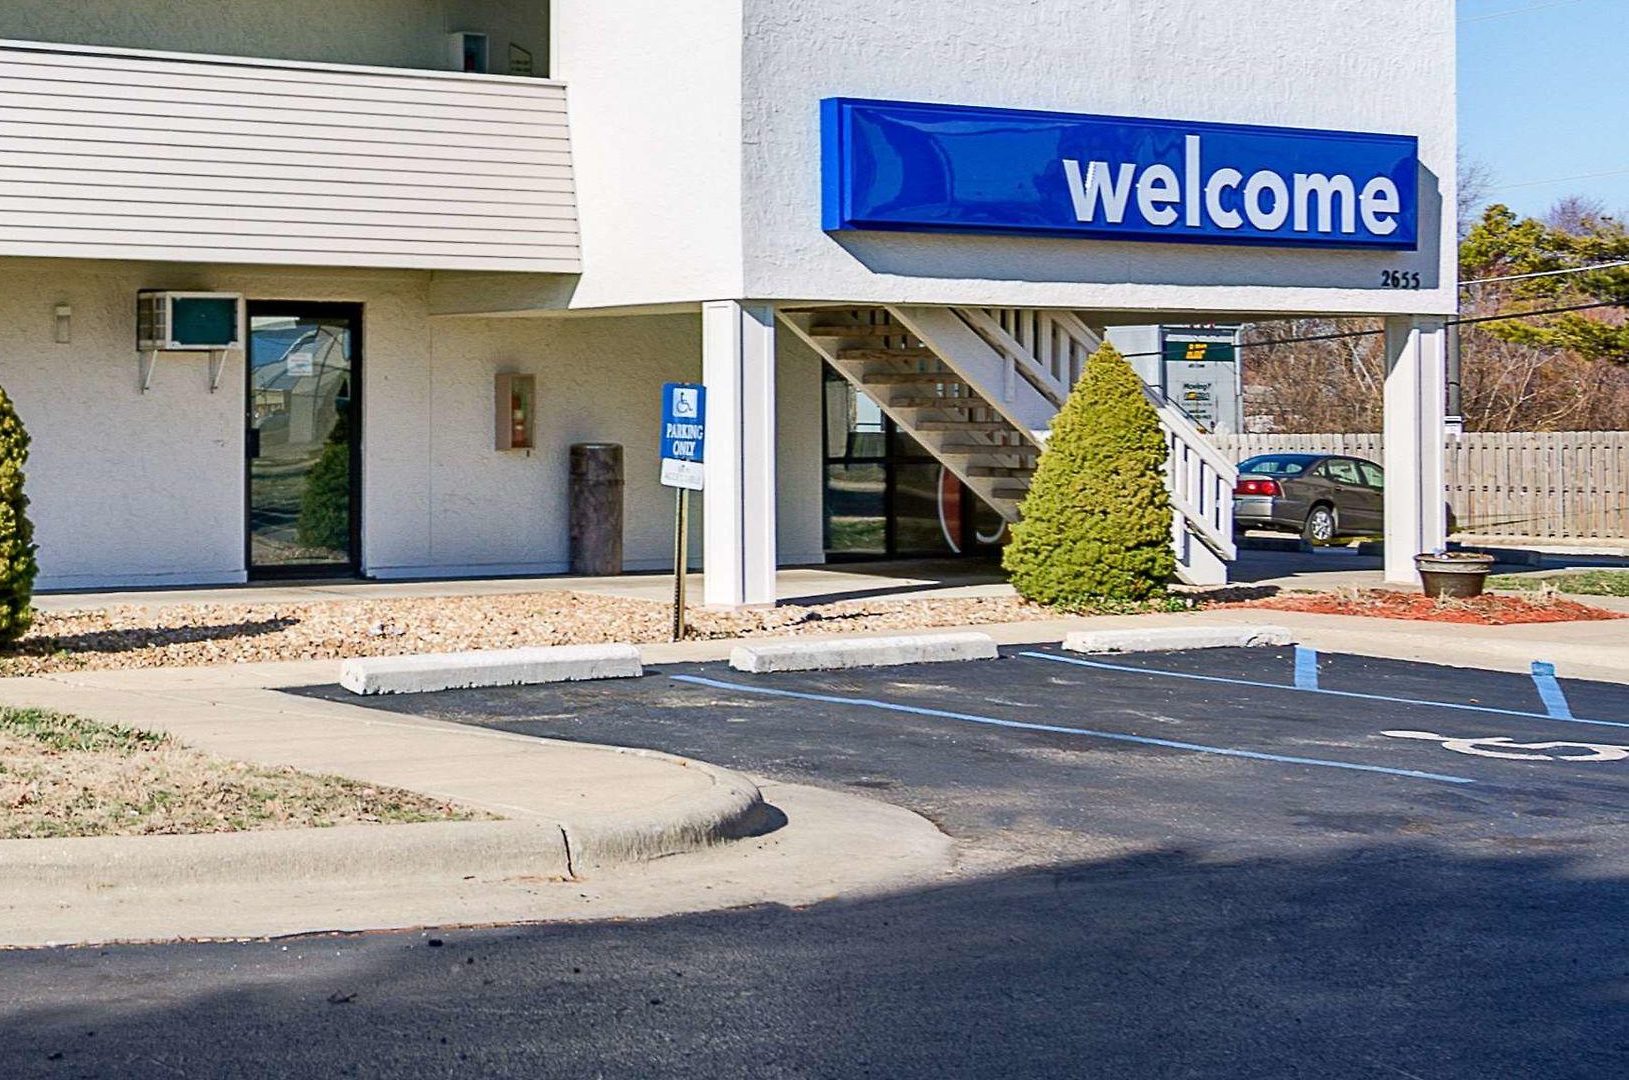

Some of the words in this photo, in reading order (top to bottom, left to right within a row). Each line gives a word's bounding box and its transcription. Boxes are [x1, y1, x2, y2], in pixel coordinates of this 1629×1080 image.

[1062, 134, 1401, 236] welcome
[1380, 269, 1421, 290] 2655
[666, 423, 704, 440] PARKING
[673, 440, 696, 457] ONLY
